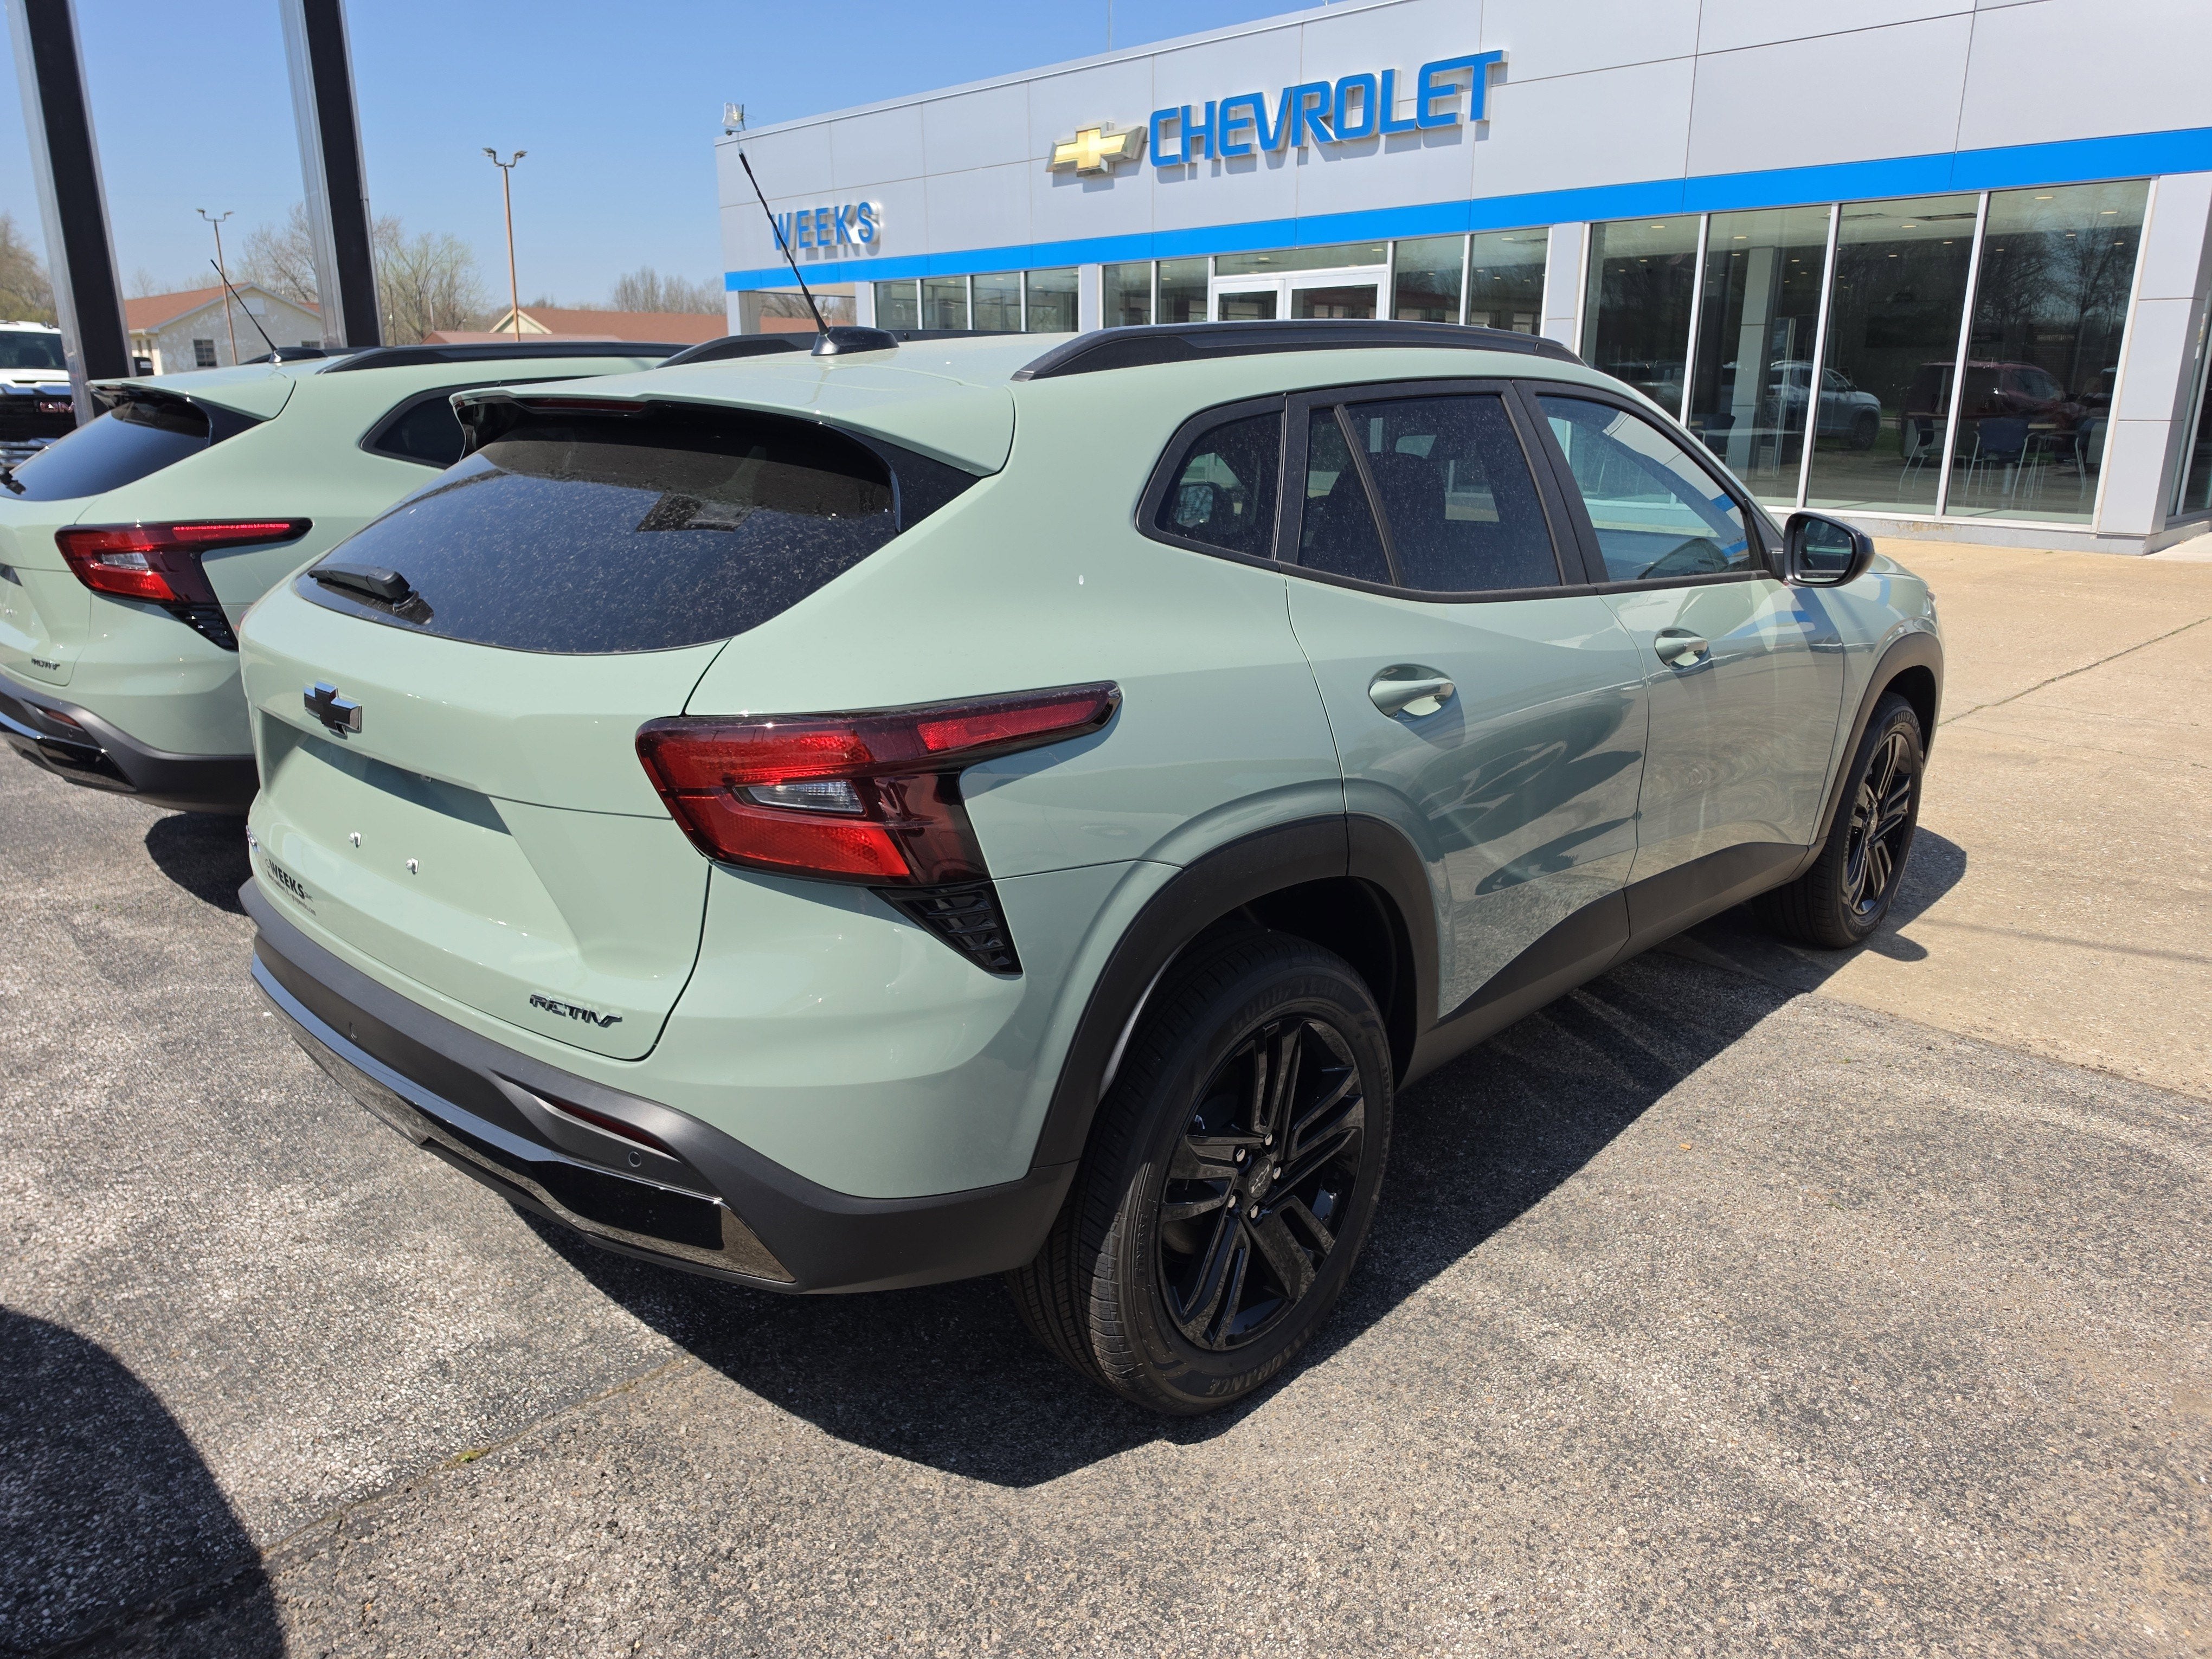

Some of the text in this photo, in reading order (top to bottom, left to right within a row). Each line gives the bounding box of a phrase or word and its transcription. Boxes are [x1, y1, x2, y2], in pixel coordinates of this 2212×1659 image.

[1149, 50, 1508, 168] CHEVROLET
[771, 202, 875, 251] WEEKS
[40, 401, 75, 413] GM
[268, 858, 305, 900] WEEKS
[529, 993, 623, 1028] ACTIV
